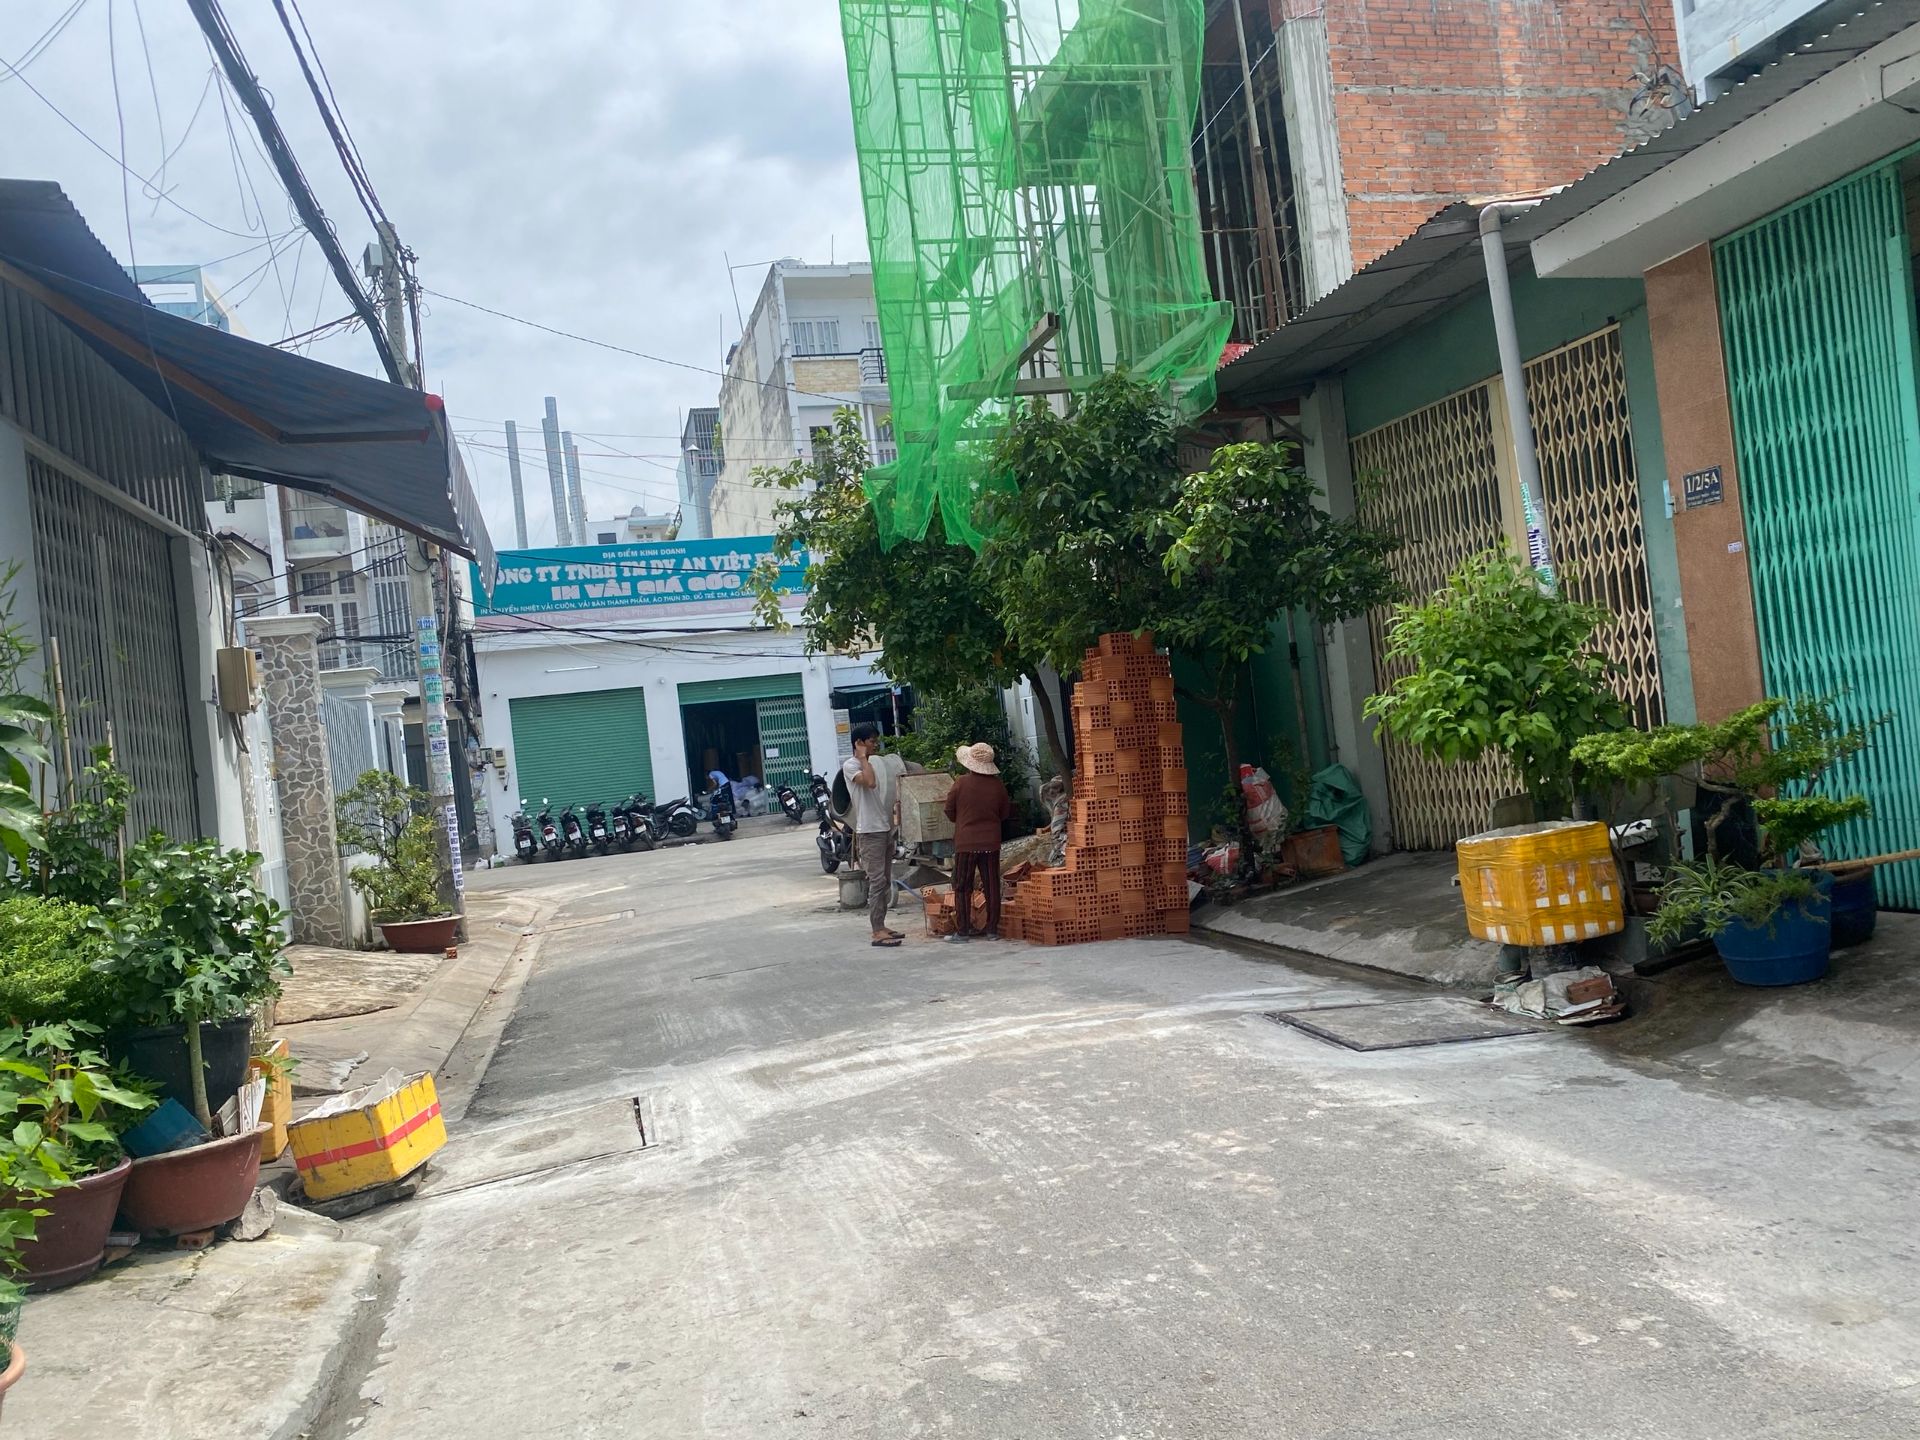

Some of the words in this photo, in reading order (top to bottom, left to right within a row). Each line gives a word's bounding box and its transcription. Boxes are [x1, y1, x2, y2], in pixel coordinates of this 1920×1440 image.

[1686, 472, 1719, 494] 1/2/5A
[617, 548, 638, 557] ĐIỂM
[493, 566, 533, 585] ÔNG
[536, 566, 561, 581] TY
[565, 563, 617, 579] TNHH
[620, 560, 647, 577] TM
[650, 558, 676, 575] DV
[680, 556, 706, 573] AN
[709, 550, 752, 571] VIỆT
[552, 586, 580, 600] IN
[585, 579, 631, 597] VẢI
[637, 575, 683, 594] GIÁ
[688, 572, 740, 590] GỐC
[664, 594, 681, 602] THUN
